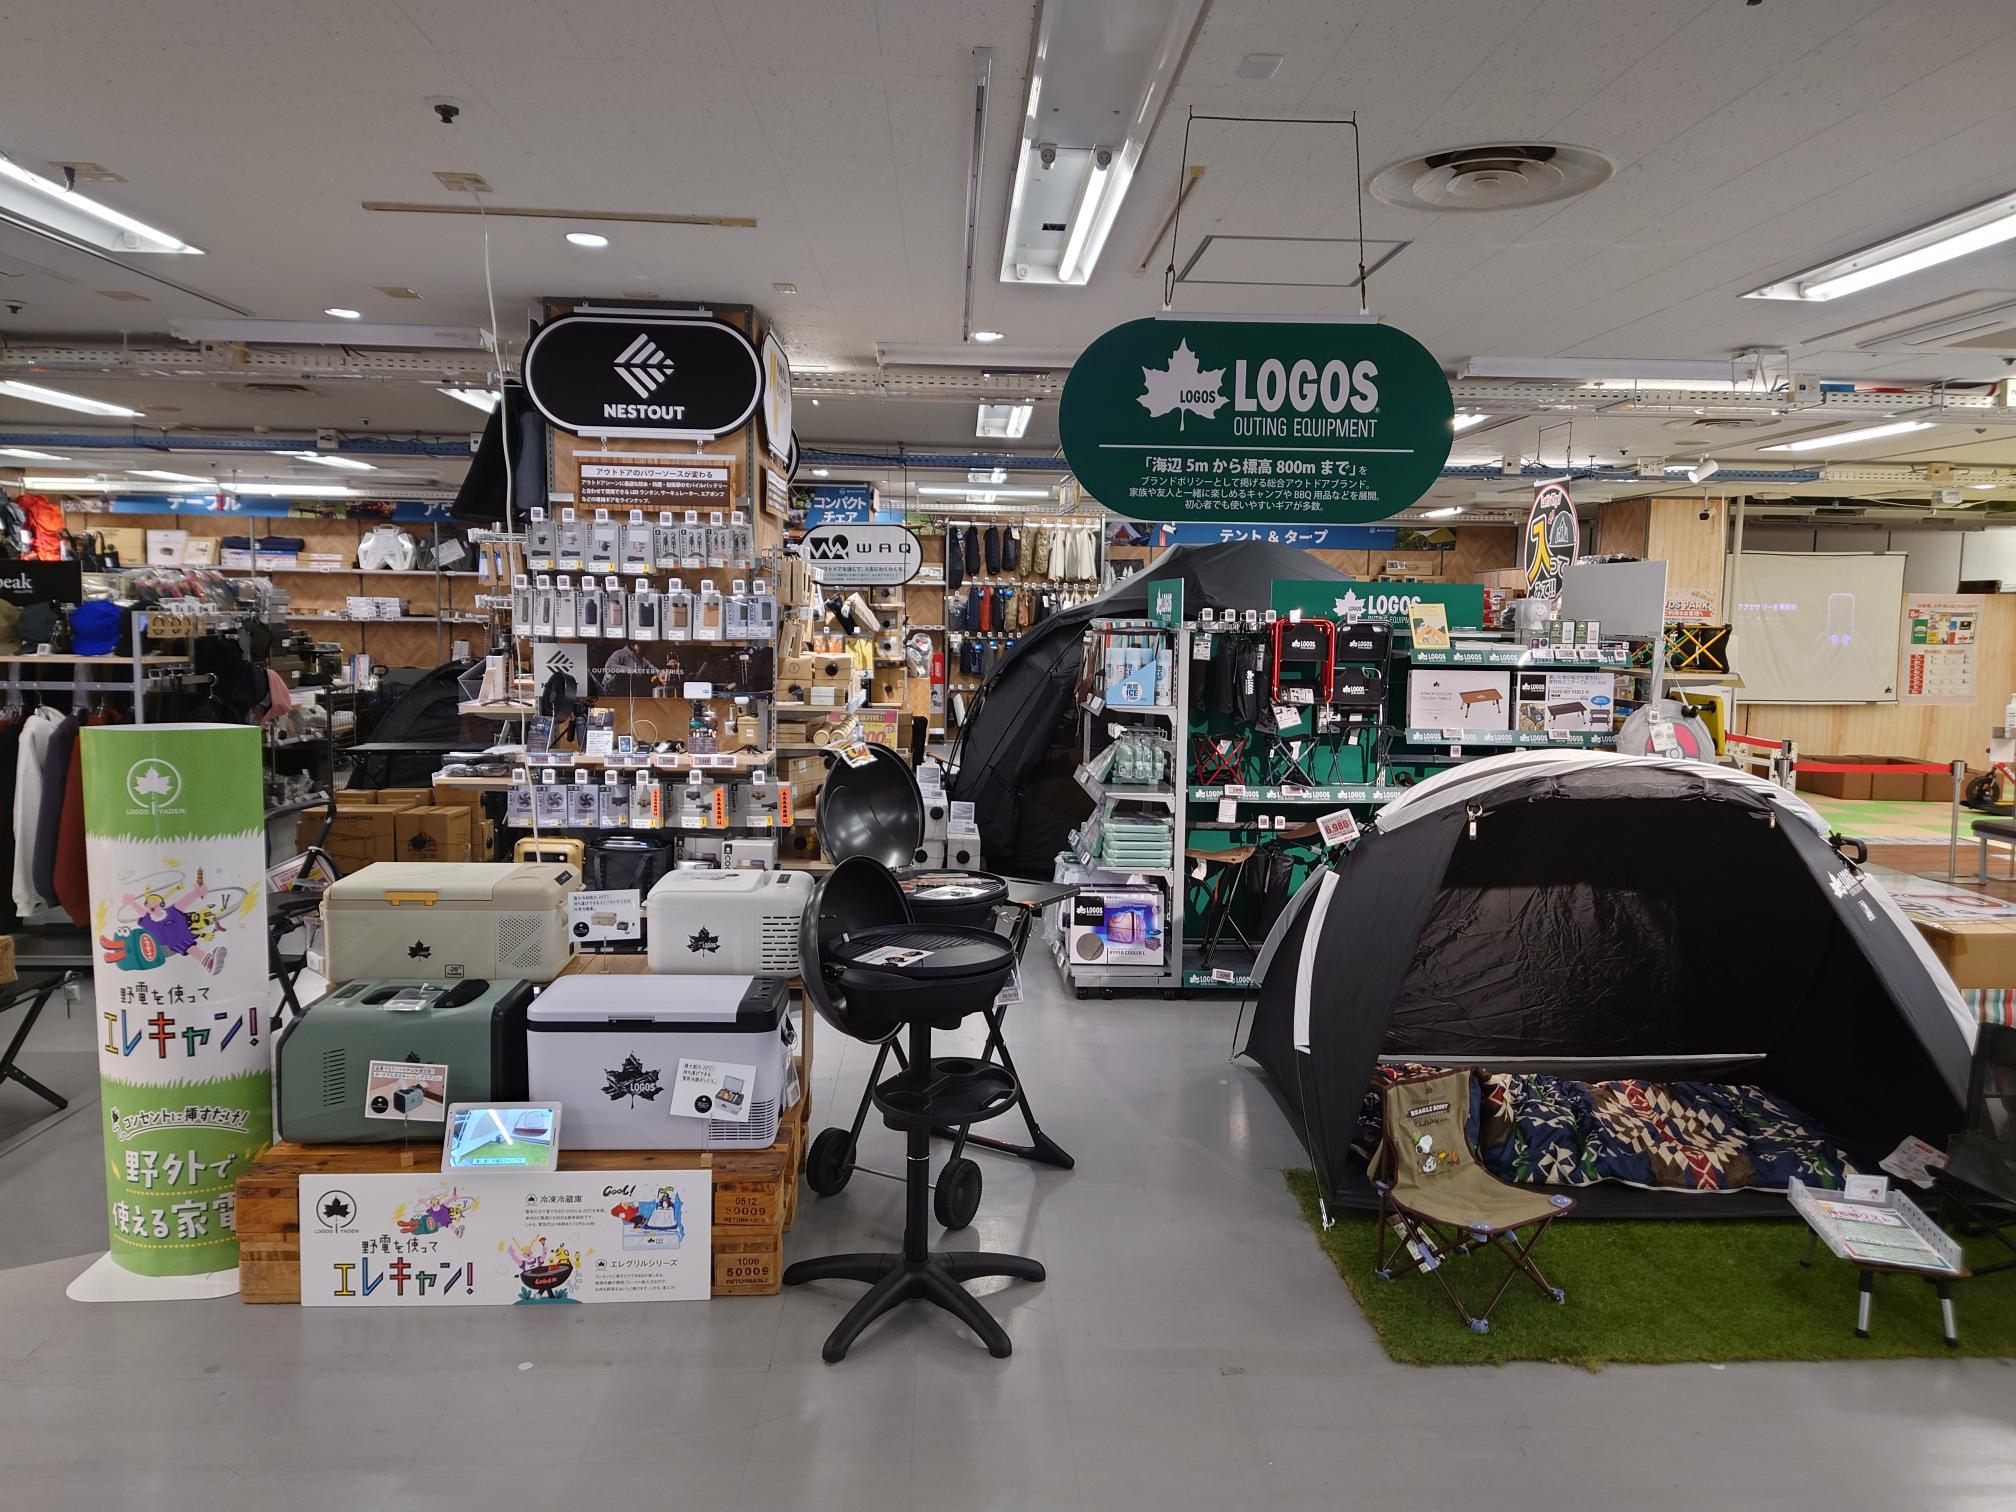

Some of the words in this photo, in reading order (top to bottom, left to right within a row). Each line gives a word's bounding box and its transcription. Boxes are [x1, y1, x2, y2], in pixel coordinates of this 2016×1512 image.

[1235, 358, 1379, 413] LOGOS
[1179, 389, 1216, 404] LOGOS
[603, 403, 685, 420] NESTOUT
[1233, 416, 1287, 437] OUTING
[1293, 417, 1378, 438] EQUIPMENT
[1144, 456, 1182, 472] 「海辺
[1186, 458, 1209, 473] 5m
[1212, 458, 1273, 474] から標高
[1276, 460, 1316, 474] 800m
[1320, 460, 1368, 477] まで」を
[596, 468, 713, 479] アウトドアのパワーソースが変わる
[1141, 476, 1371, 489] ブランドポリシーとして掲げる総合アウトドアブランド。
[1129, 487, 1293, 499] 家族や友人と一緒に楽しめるキャンプや
[1294, 490, 1313, 500] BBQ
[1313, 490, 1381, 501] 用品などを展開。
[813, 496, 867, 510] コンパクト
[1185, 500, 1325, 511] 初心者でも使いやすいギアが多数。
[823, 510, 858, 523] チェア
[1219, 528, 1262, 543] テント
[1267, 530, 1280, 543] &
[1284, 528, 1329, 544] タープ
[856, 543, 911, 554] WAQ
[1530, 683, 1545, 691] LOGOS
[1312, 791, 1331, 799] LOGOS
[1347, 791, 1366, 799] LOGOS
[1324, 819, 1350, 835] 6,980
[1086, 906, 1103, 914] LOGOS
[120, 981, 210, 1005] 野電を使って
[630, 1082, 656, 1092] LOGOS
[125, 1150, 236, 1188] 野外で
[540, 1195, 583, 1204] 冷凍冷蔵庫
[735, 1197, 757, 1206] 0512
[726, 1207, 766, 1216] 50009
[361, 1234, 438, 1254] 野電を使って
[610, 1258, 678, 1268] エレグリルシリーズ
[333, 1256, 474, 1297] エレキャン!
[727, 1267, 769, 1276] 50009
